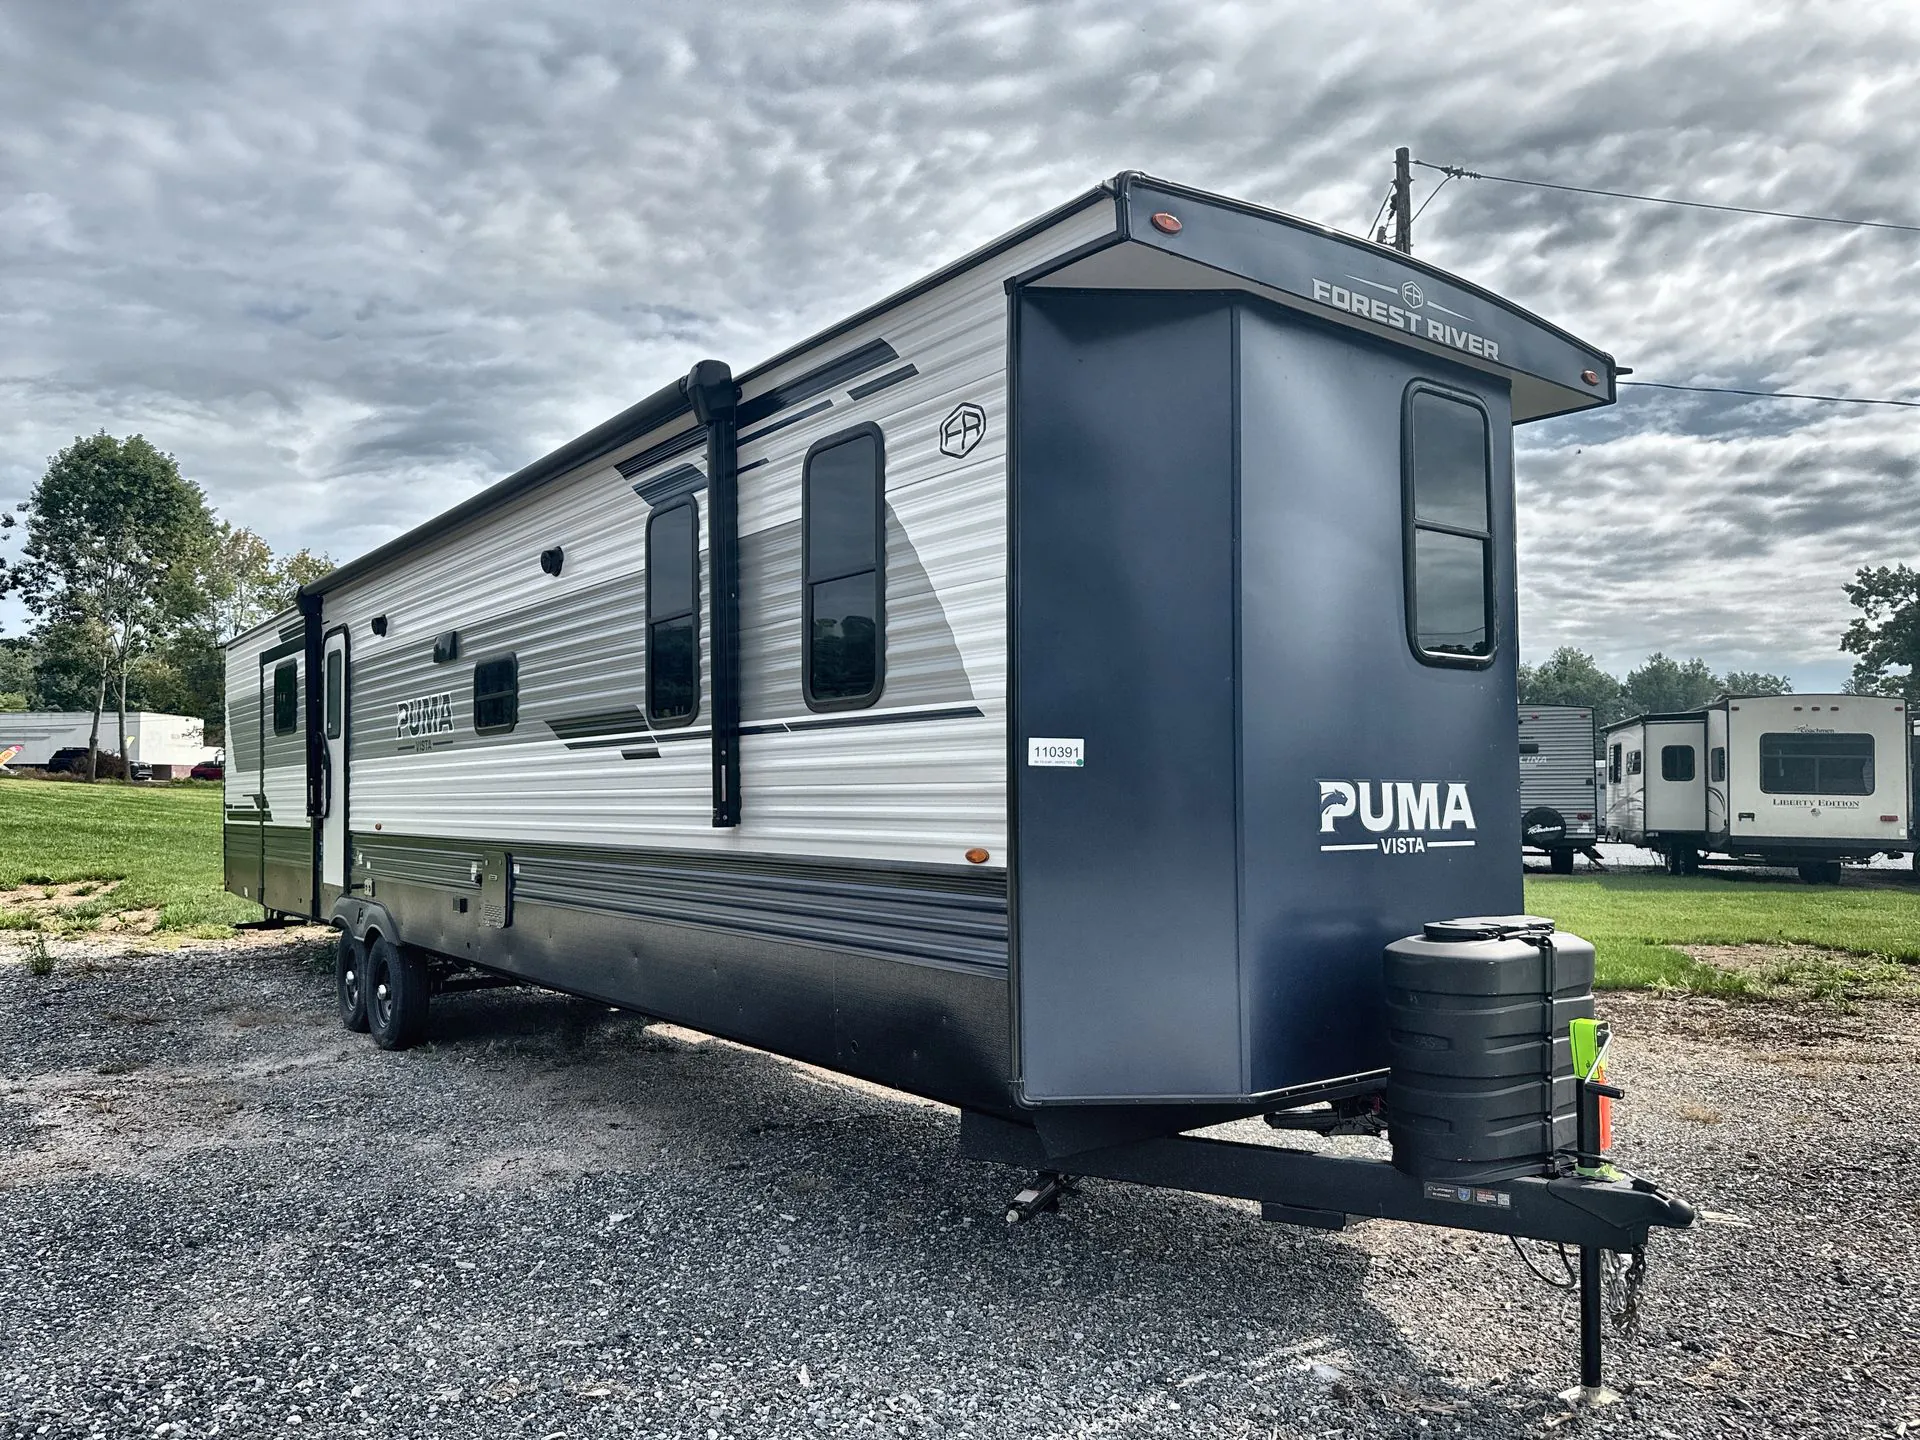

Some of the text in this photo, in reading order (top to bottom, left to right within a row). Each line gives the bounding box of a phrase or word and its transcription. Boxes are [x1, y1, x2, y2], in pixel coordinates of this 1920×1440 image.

[1312, 278, 1499, 360] FOREST RIVER
[396, 691, 454, 740] PUMA
[415, 739, 432, 752] VISTA
[1034, 746, 1079, 758] 110391
[1317, 780, 1477, 833] PUMA
[1773, 798, 1859, 807] LIBERTY EDITION
[1380, 837, 1425, 854] VISTA
